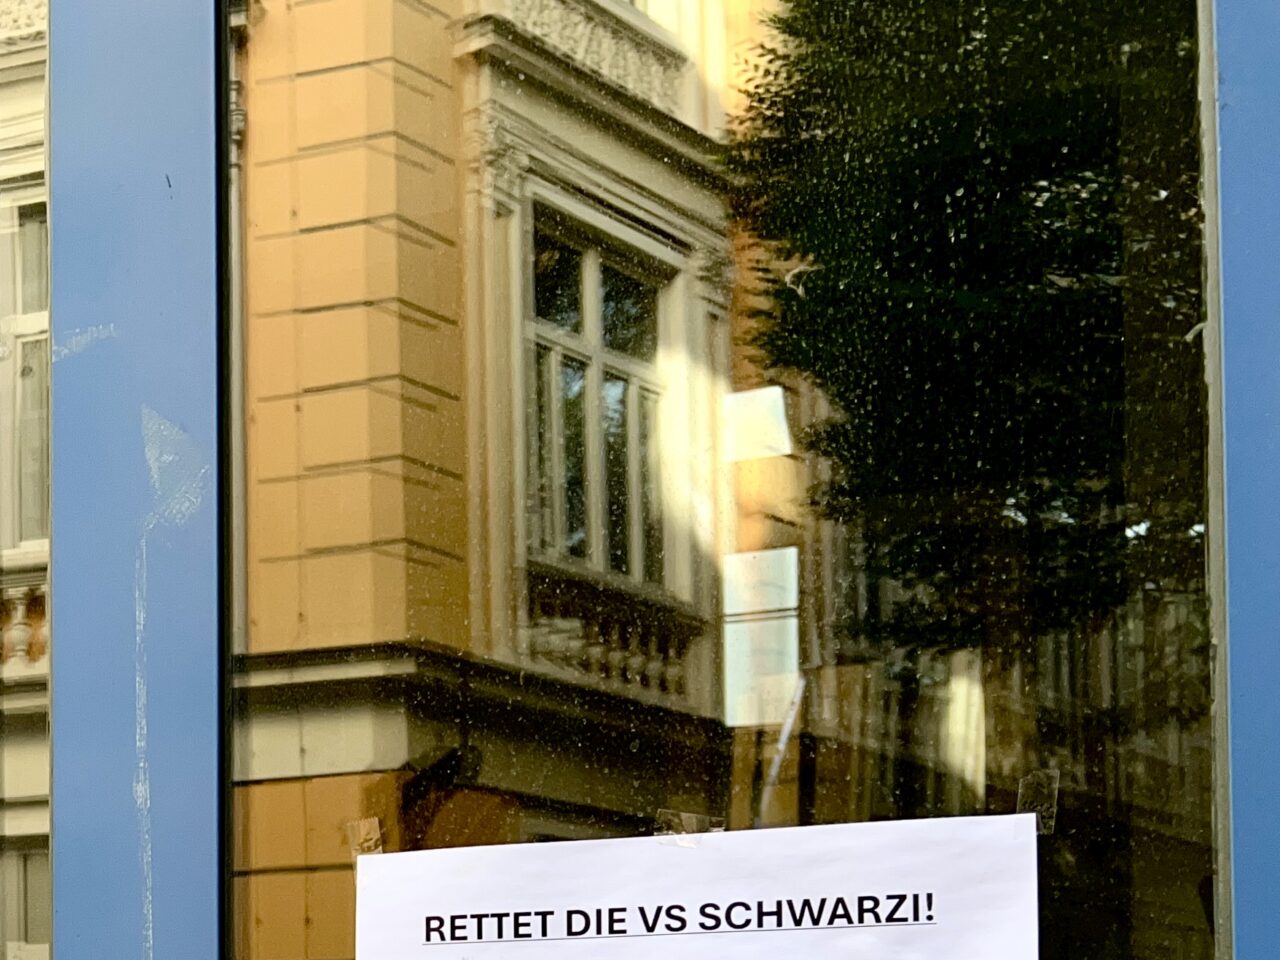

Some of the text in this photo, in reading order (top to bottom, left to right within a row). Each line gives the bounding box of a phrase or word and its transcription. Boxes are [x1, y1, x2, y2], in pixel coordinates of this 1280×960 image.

[424, 892, 935, 942] RETTET DIE VS SCHWARZI!
